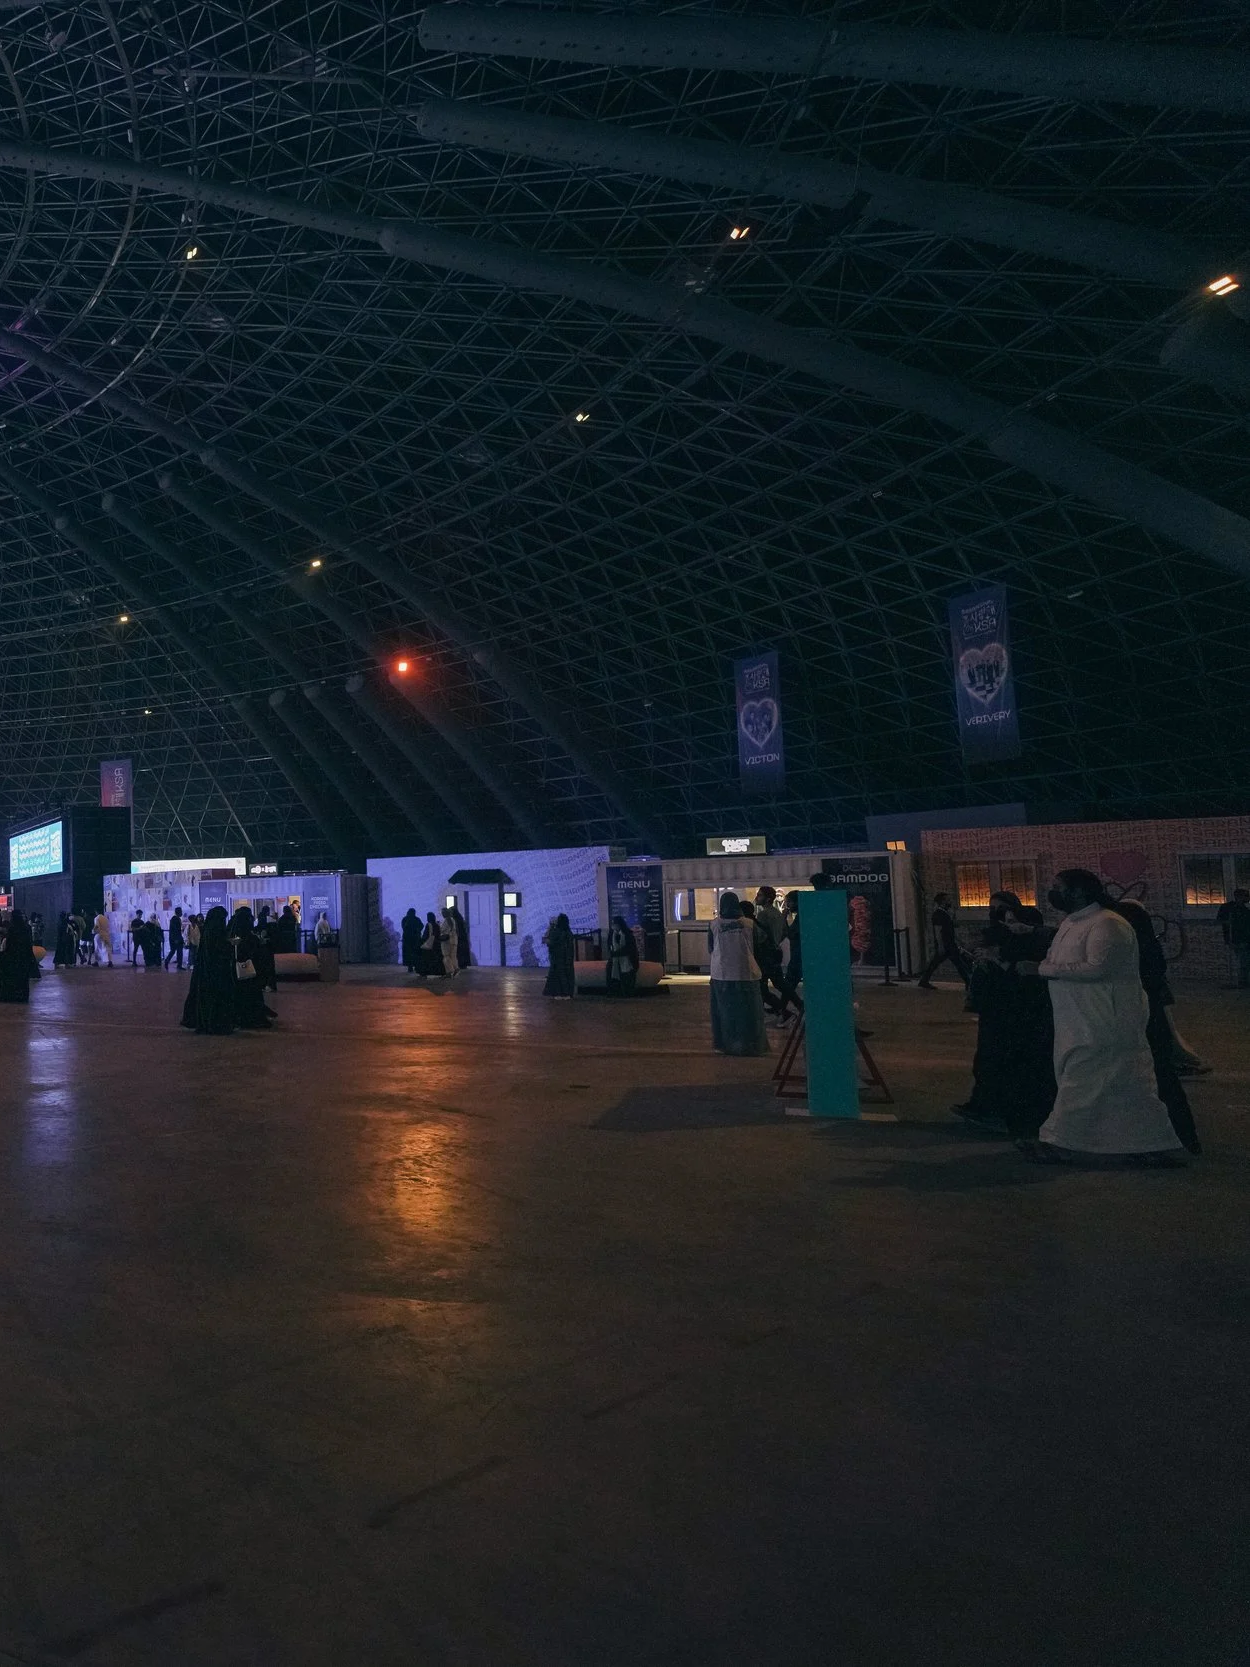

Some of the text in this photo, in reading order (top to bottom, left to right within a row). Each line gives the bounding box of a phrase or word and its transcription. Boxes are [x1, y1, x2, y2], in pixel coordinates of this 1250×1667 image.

[965, 710, 1011, 726] VERIVERY
[745, 753, 780, 765] VICTON
[114, 768, 125, 792] KSA
[617, 881, 650, 889] MENU
[205, 896, 222, 904] MENU
